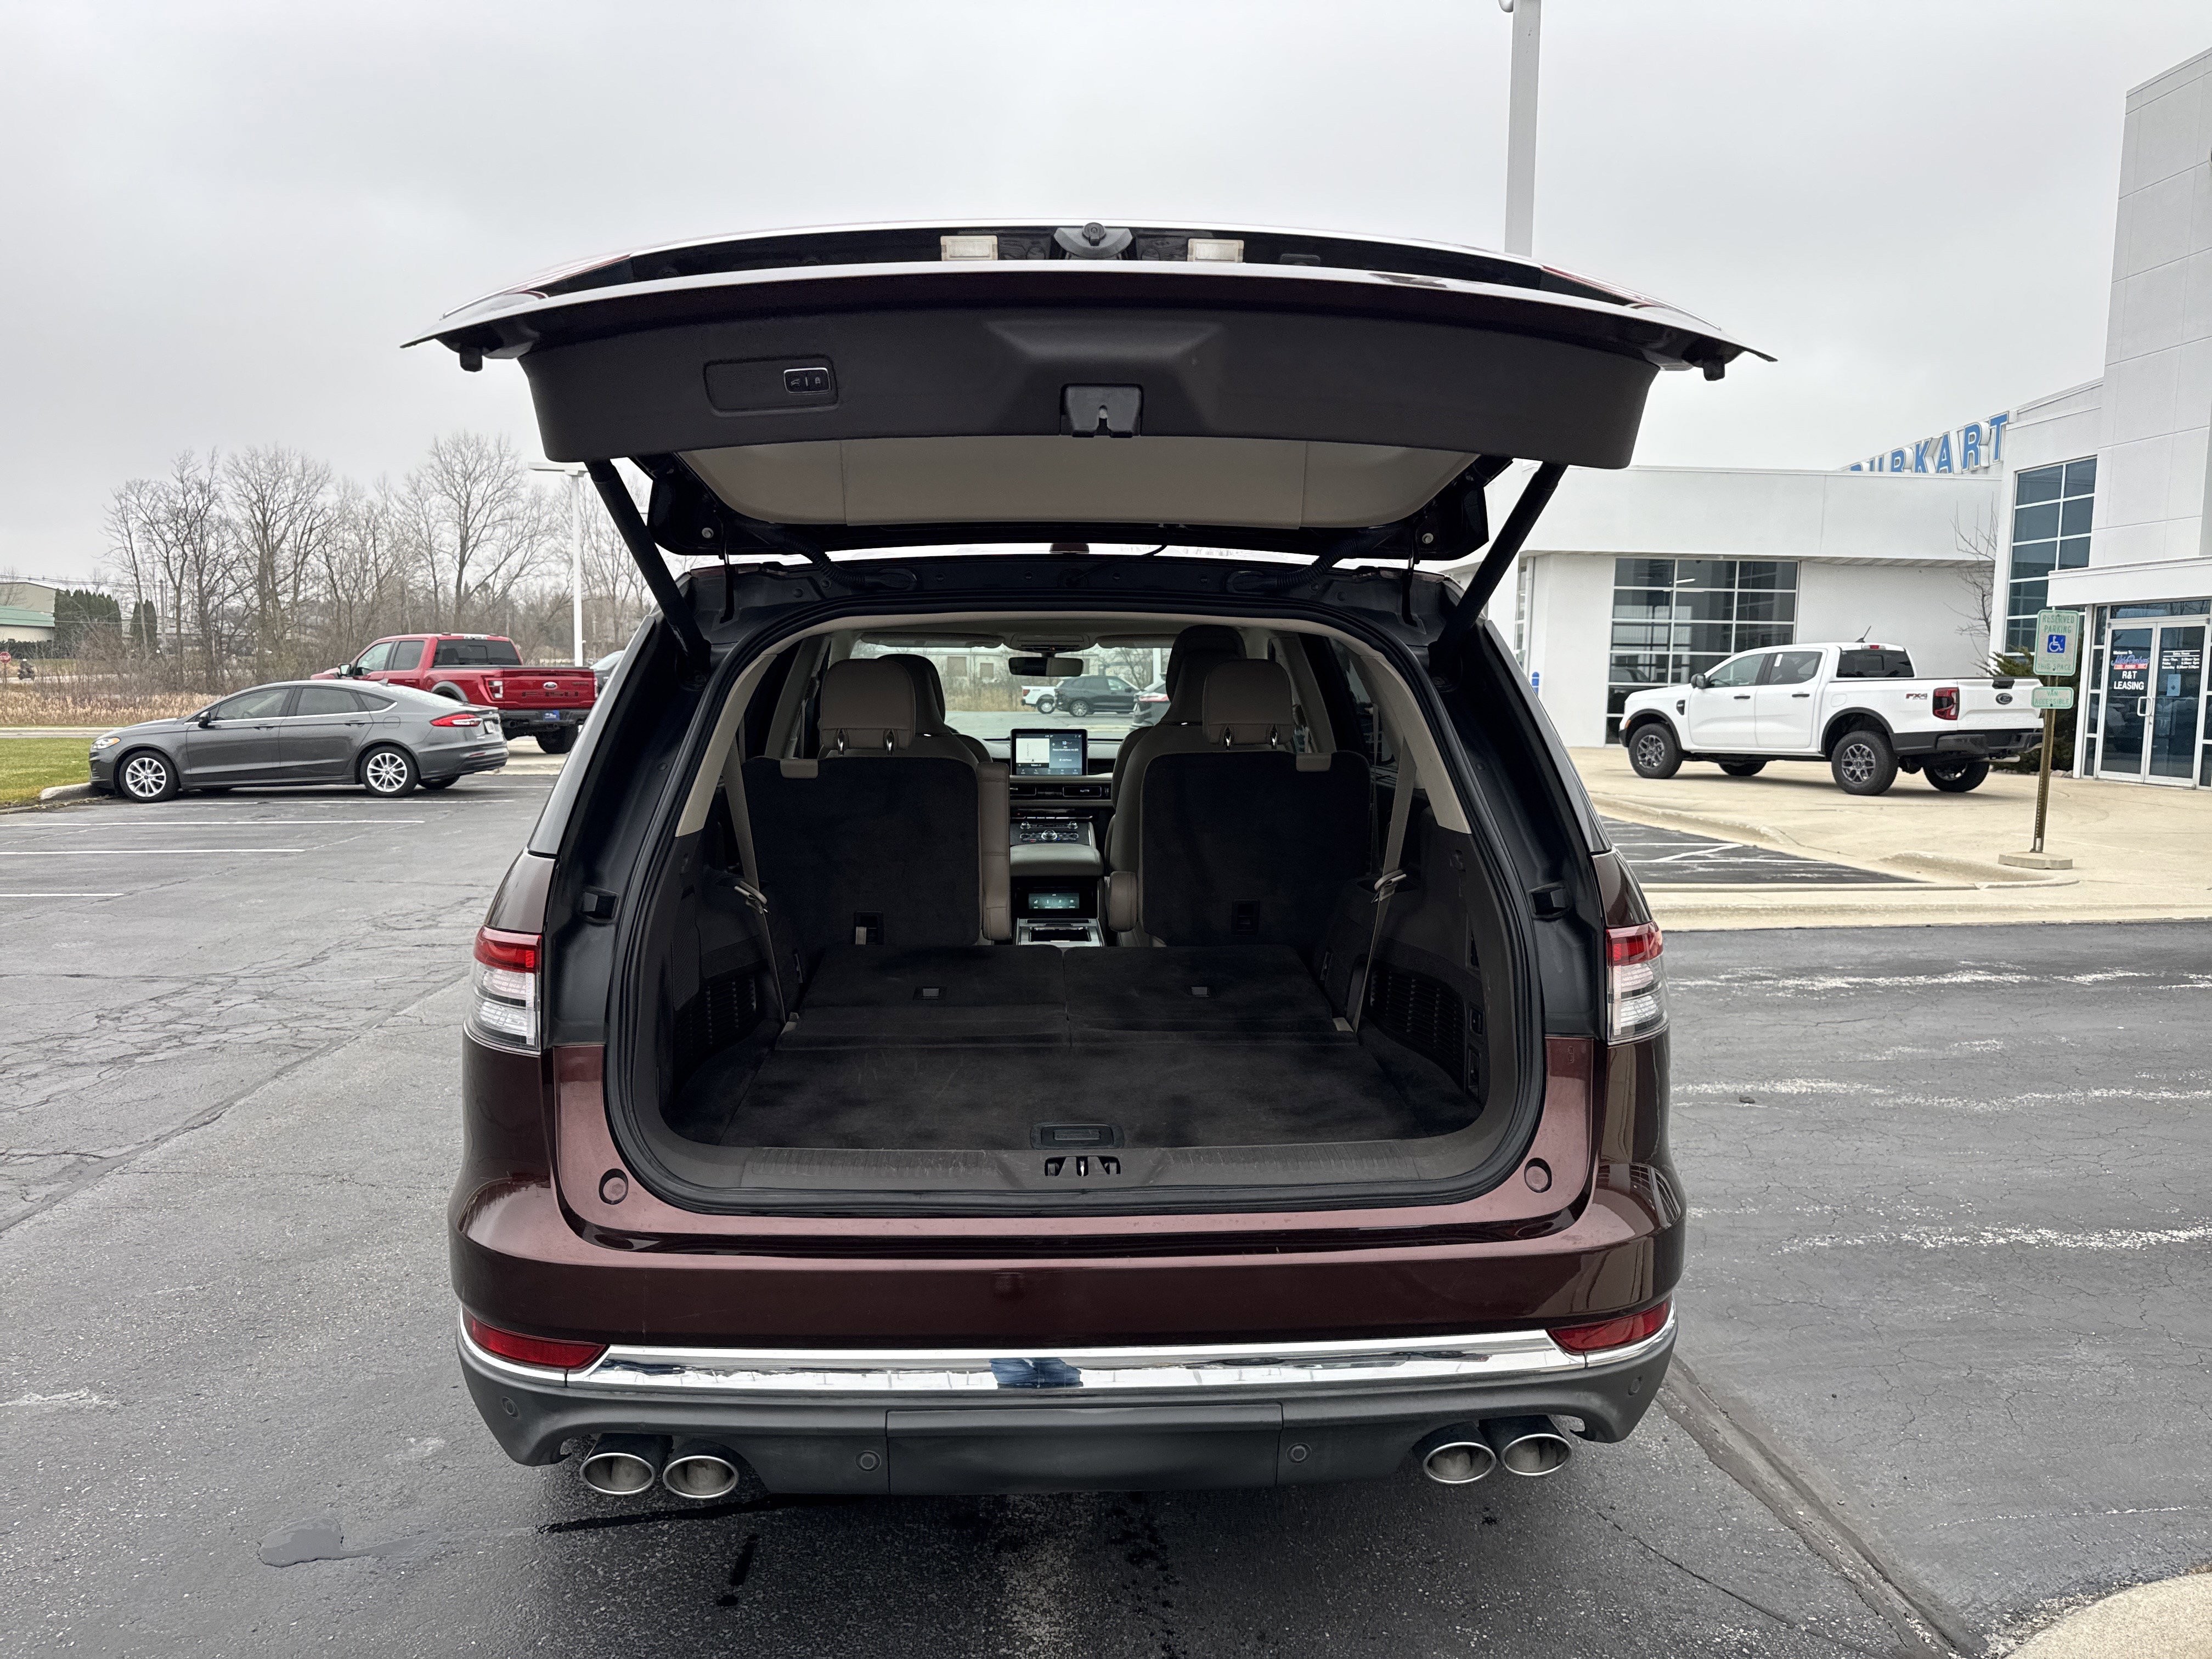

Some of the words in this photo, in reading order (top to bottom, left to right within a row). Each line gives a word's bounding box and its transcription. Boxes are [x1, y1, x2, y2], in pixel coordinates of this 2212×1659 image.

[1849, 413, 2009, 474] RKART
[2042, 614, 2074, 624] RESERVED
[2044, 625, 2072, 634] PARKING
[2122, 670, 2137, 679] R&T
[2114, 681, 2145, 690] LEASING
